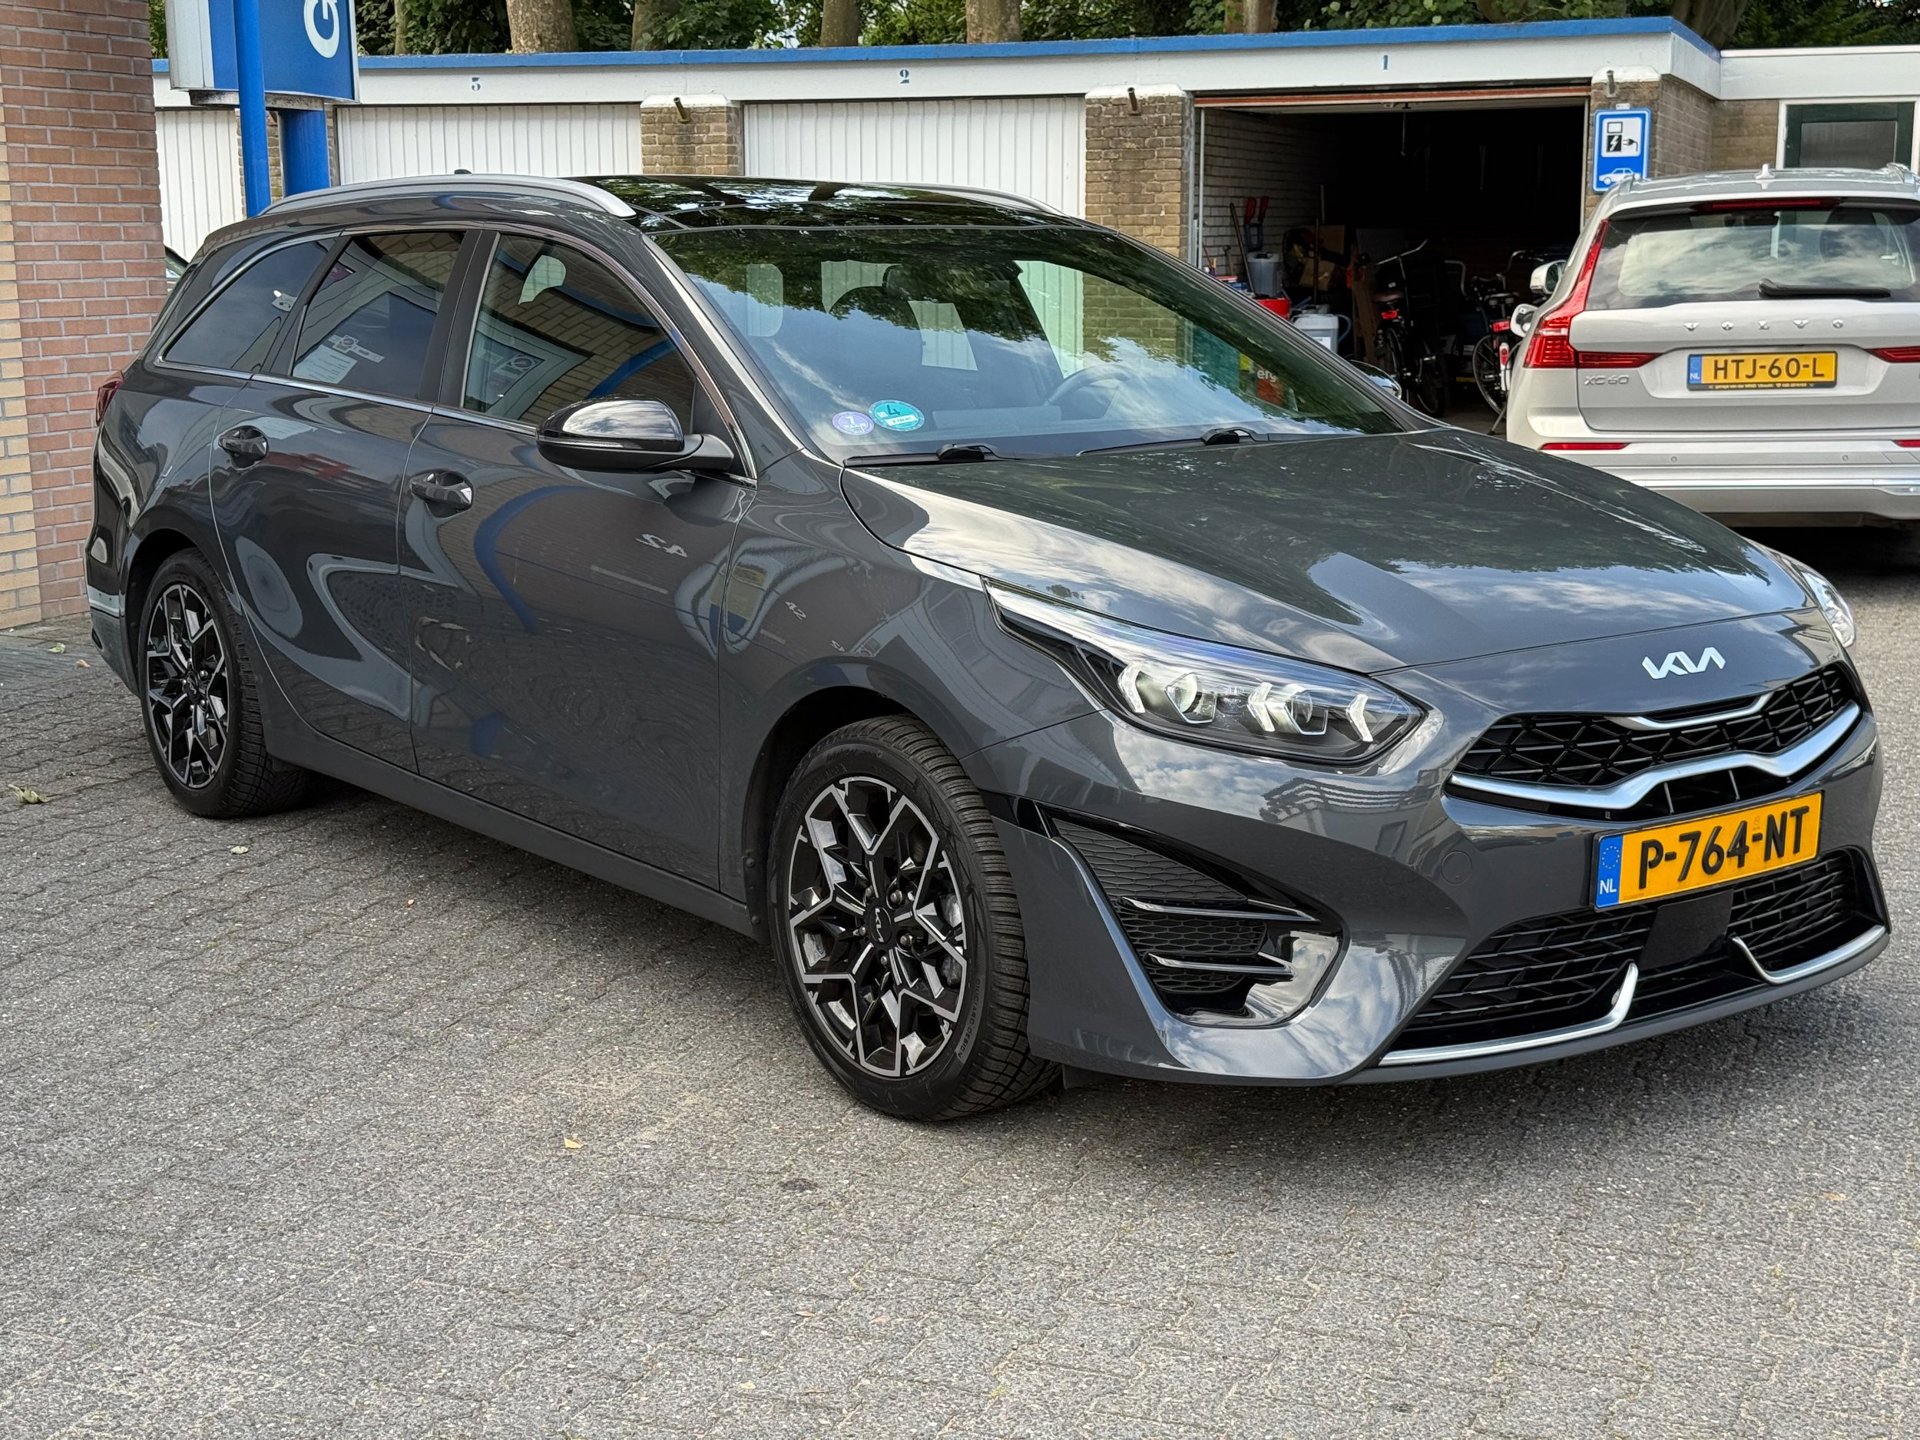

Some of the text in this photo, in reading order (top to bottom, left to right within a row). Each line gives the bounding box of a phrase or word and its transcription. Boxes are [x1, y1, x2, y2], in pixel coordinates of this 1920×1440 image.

[899, 69, 910, 84] 2
[1683, 319, 1845, 332] VOLVO
[1713, 357, 1825, 380] HTJ-60-L
[1584, 374, 1630, 386] XC60
[1689, 372, 1701, 381] NL
[1641, 646, 1726, 680] KIA
[1638, 805, 1810, 890] P-764-NT
[1599, 879, 1617, 895] NL
